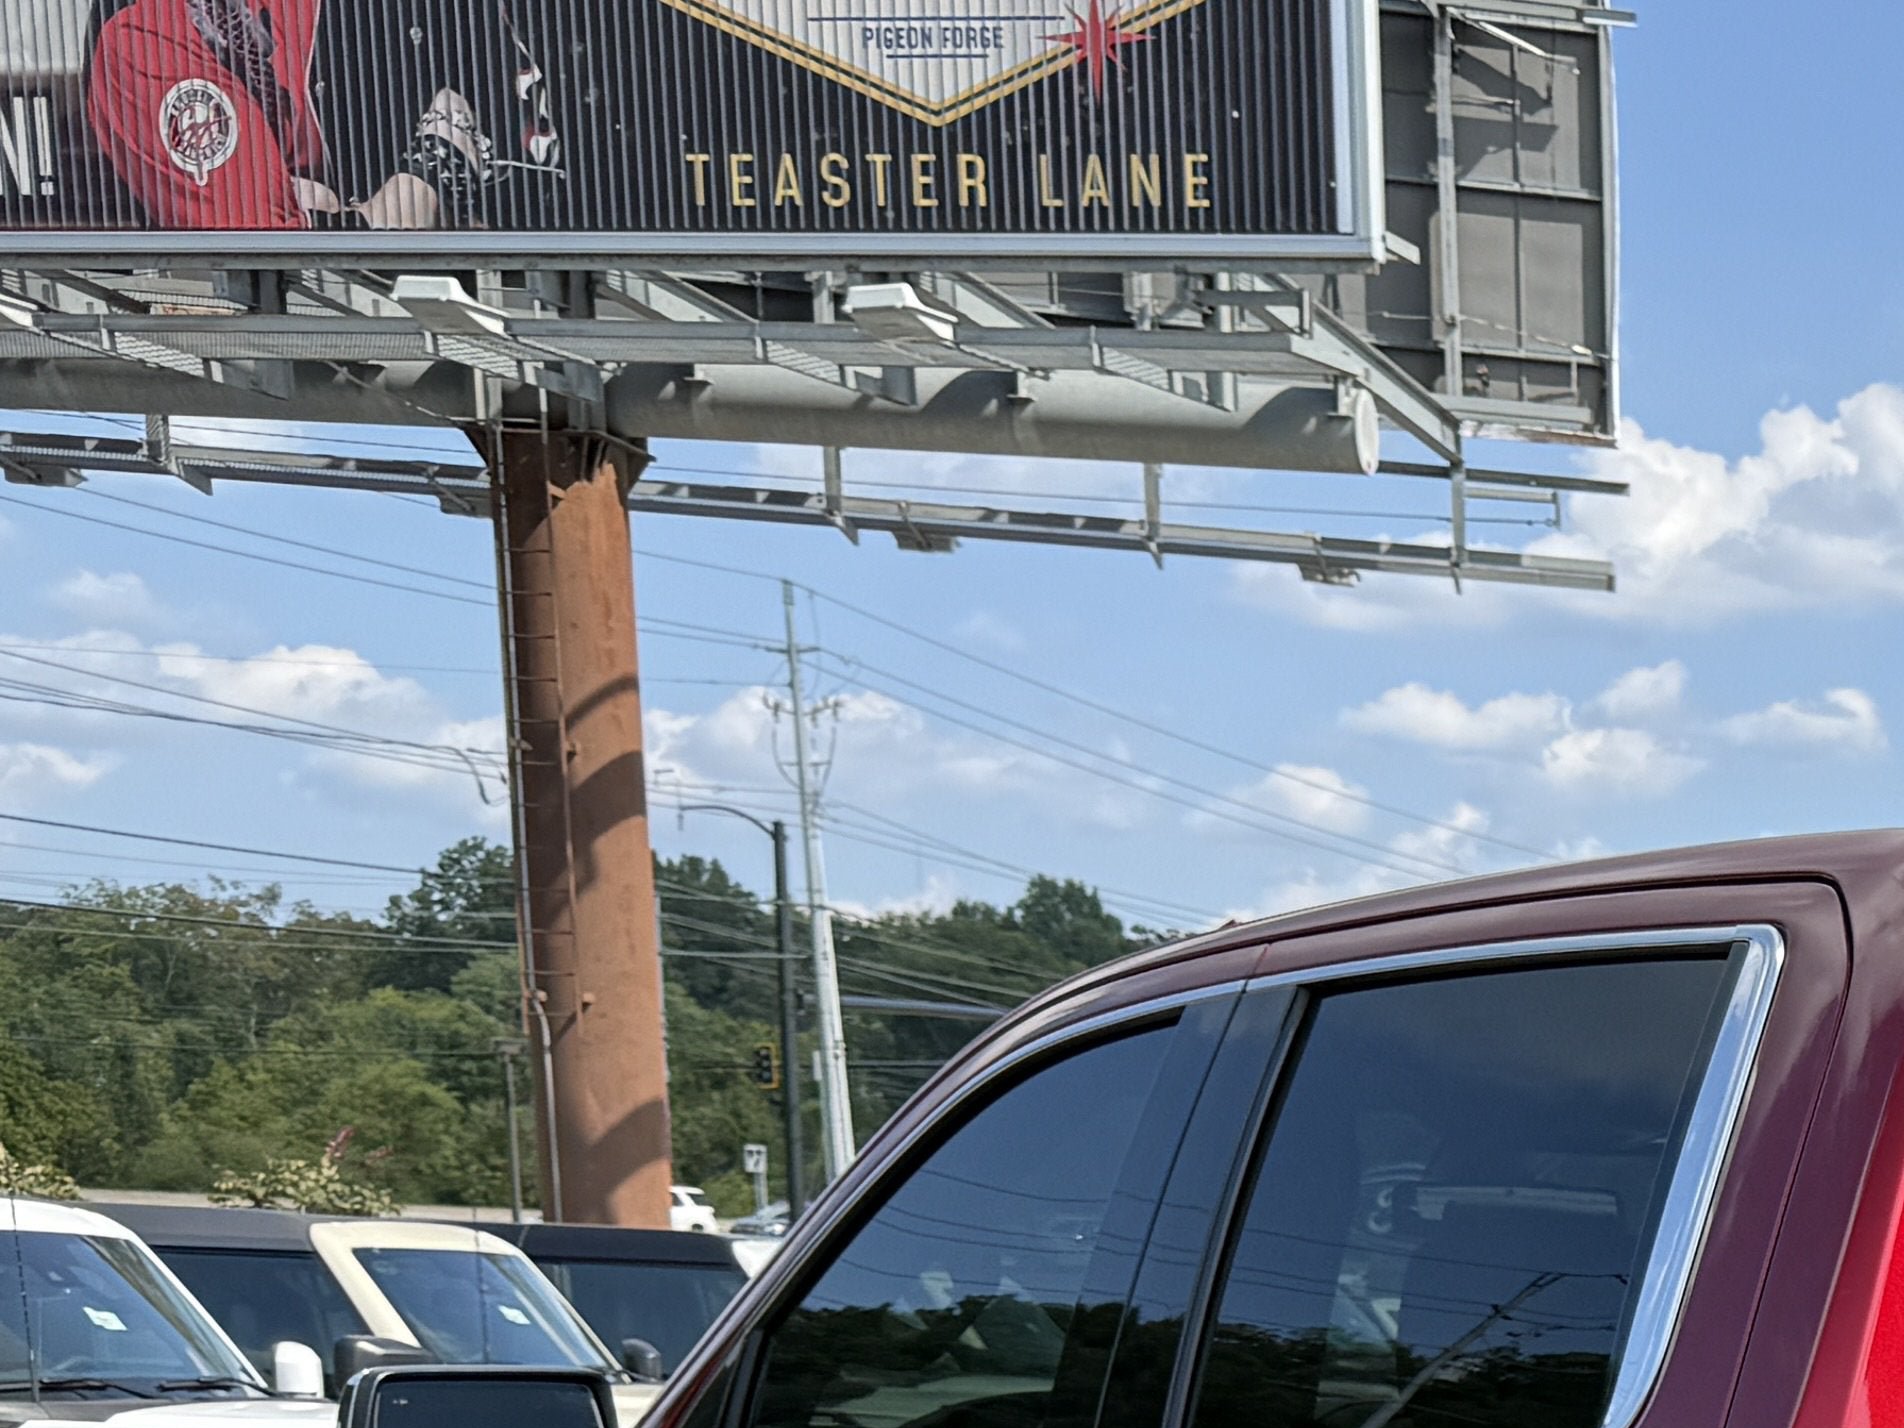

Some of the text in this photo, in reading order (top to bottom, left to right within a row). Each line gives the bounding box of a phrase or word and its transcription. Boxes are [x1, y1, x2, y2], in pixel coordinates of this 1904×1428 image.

[862, 26, 1004, 49] PIGEON FORGE
[686, 153, 1212, 209] TEASTER LANE
